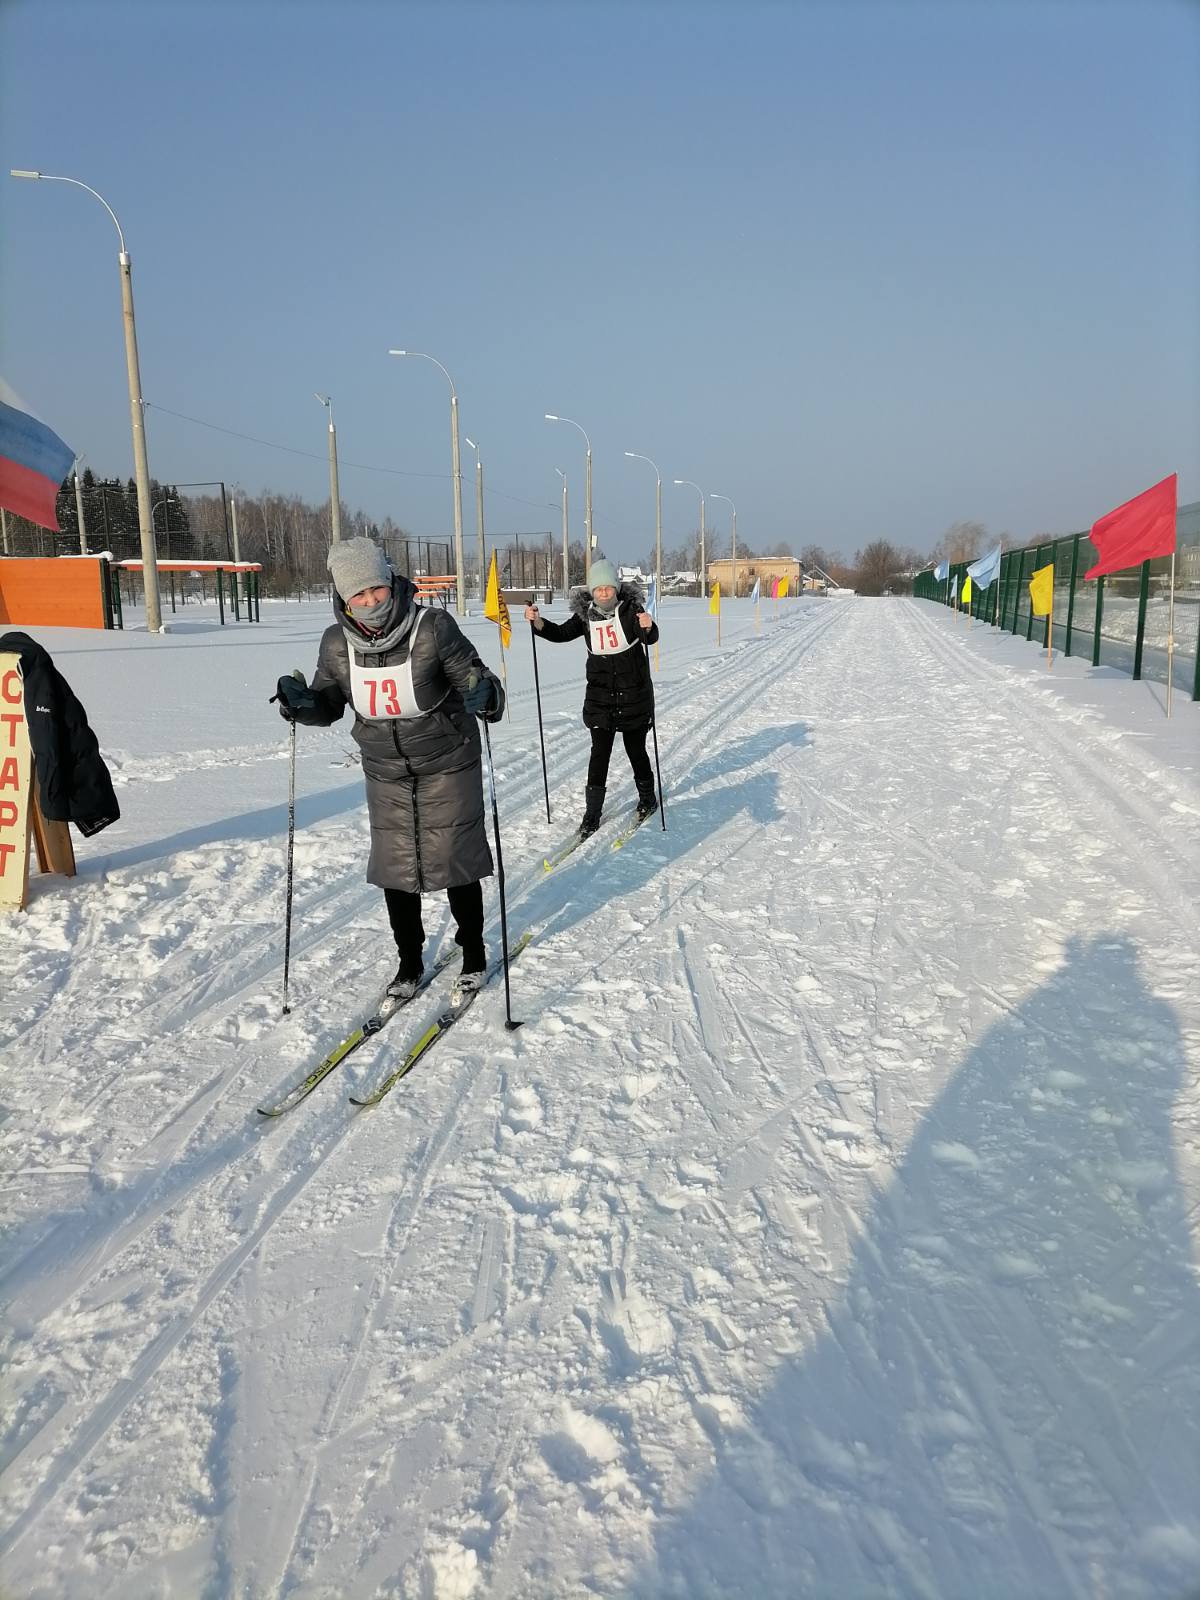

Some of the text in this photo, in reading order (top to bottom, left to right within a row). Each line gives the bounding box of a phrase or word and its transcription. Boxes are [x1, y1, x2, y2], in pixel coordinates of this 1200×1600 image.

[596, 624, 618, 650] 75
[364, 679, 401, 716] 73
[0, 670, 24, 877] СТАРТ
